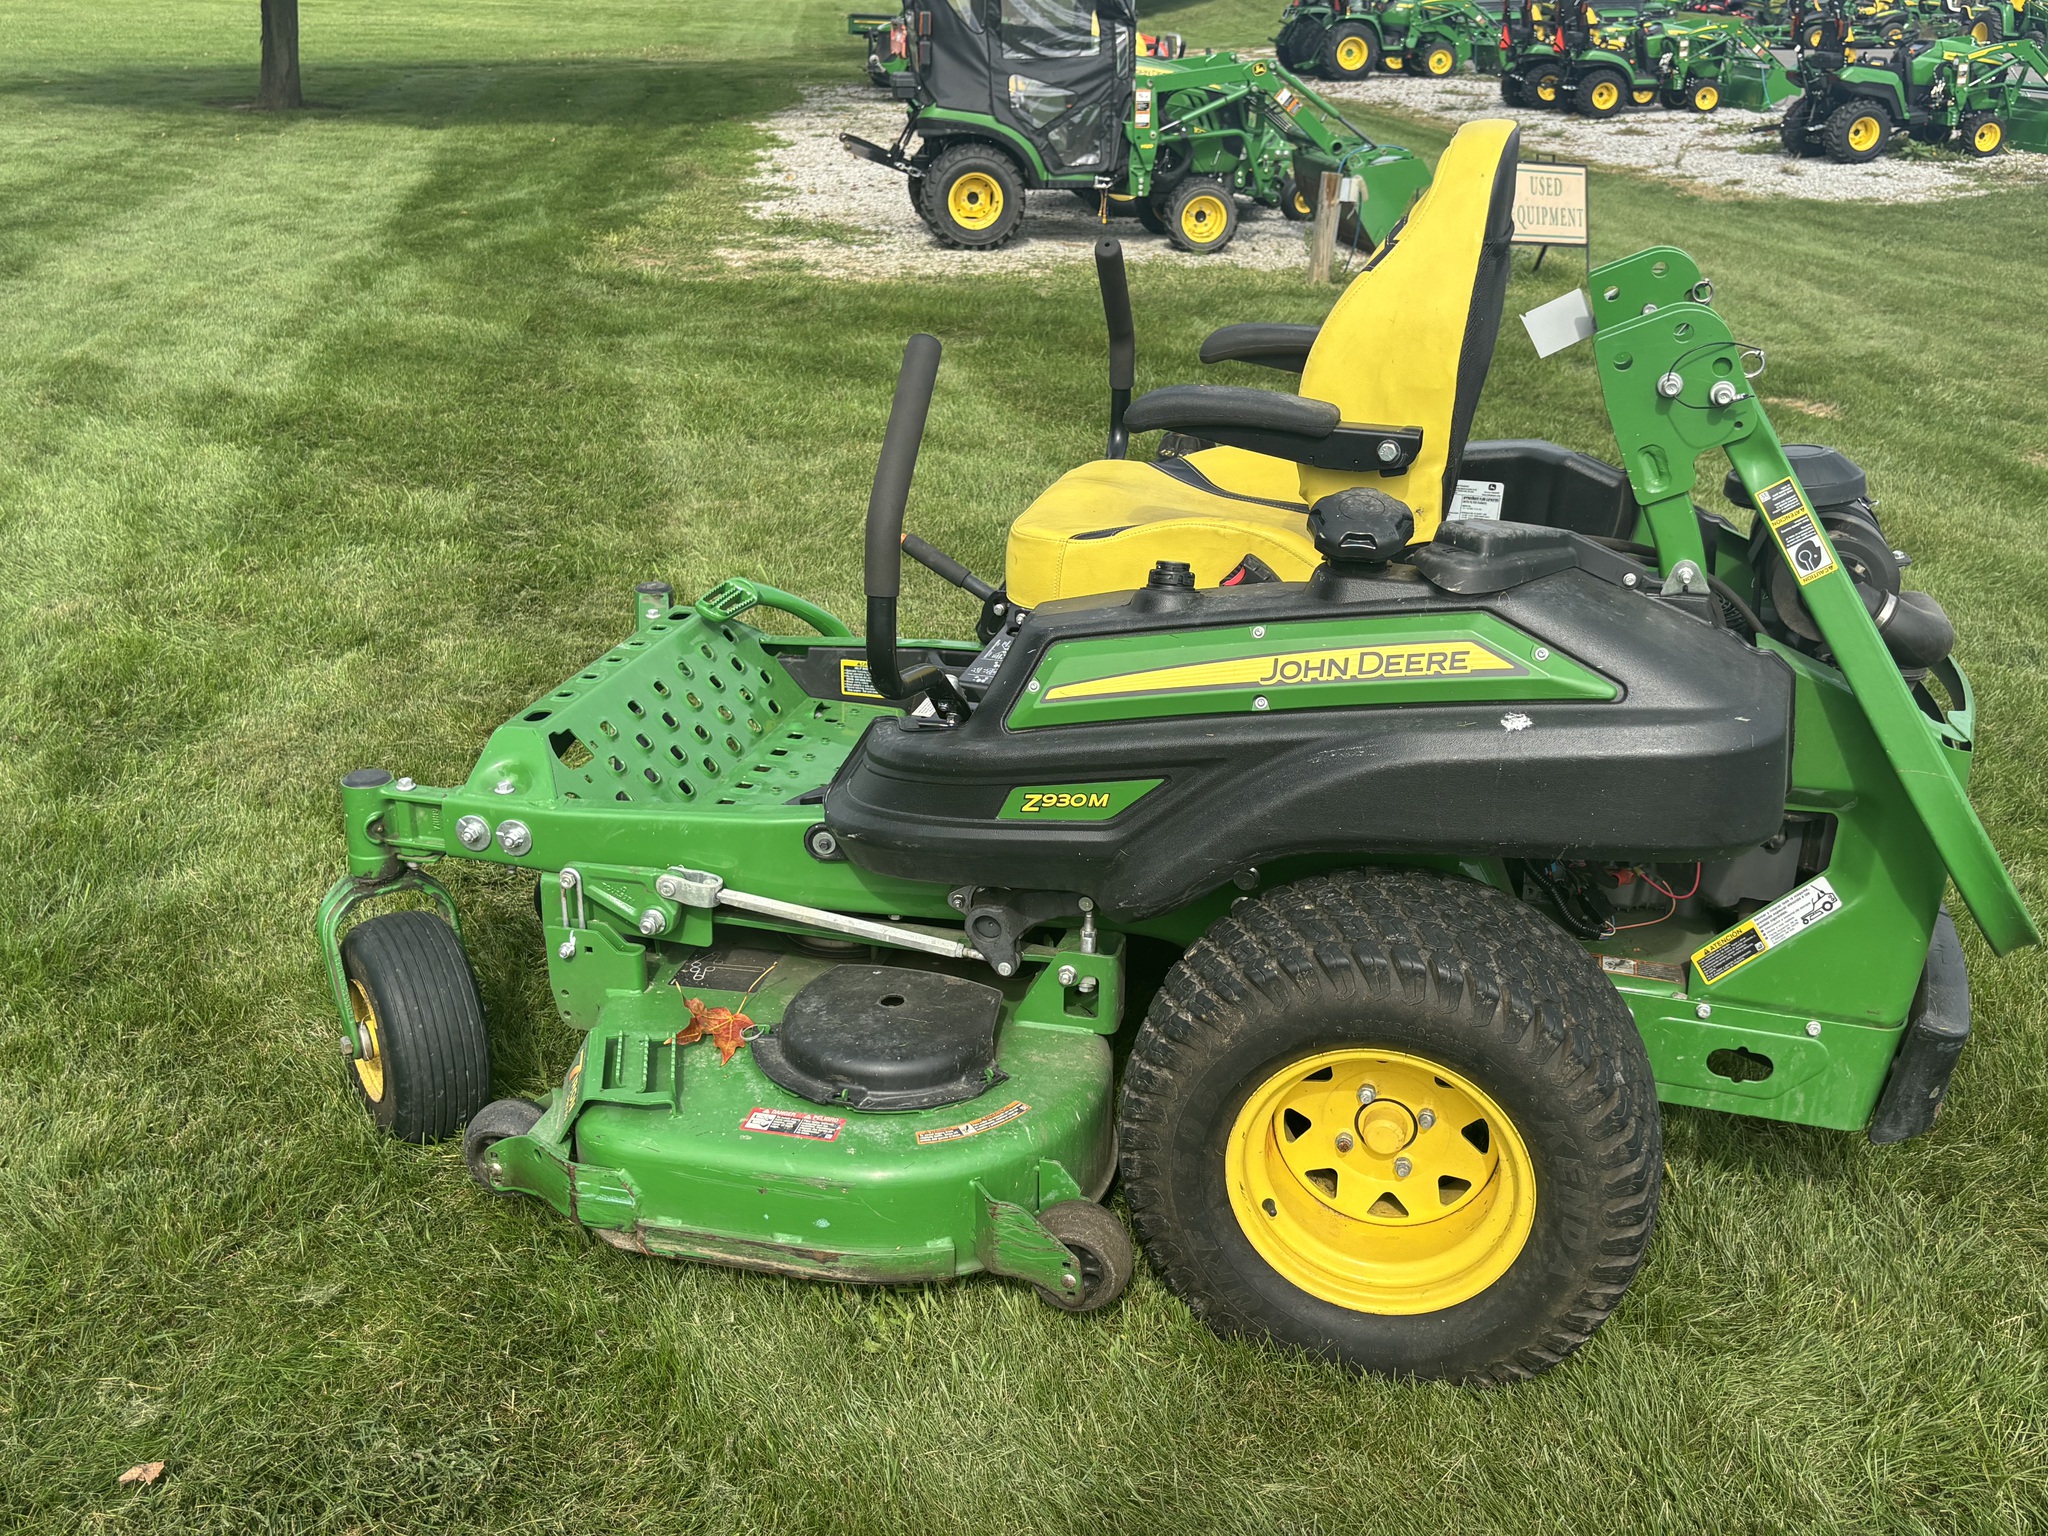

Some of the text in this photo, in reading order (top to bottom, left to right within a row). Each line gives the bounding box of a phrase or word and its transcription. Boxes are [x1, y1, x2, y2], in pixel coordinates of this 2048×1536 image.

[1530, 176, 1563, 197] USED
[1512, 205, 1584, 230] QUIPMENT
[1803, 566, 1829, 583] CAUTION
[1260, 651, 1471, 681] JOHN DEERE
[1020, 793, 1110, 812] Z930M
[1710, 928, 1743, 951] ATENCIÓN
[770, 1109, 797, 1118] DANGER
[812, 1114, 840, 1124] PELIGRO
[1537, 1120, 1590, 1277] KENDA
